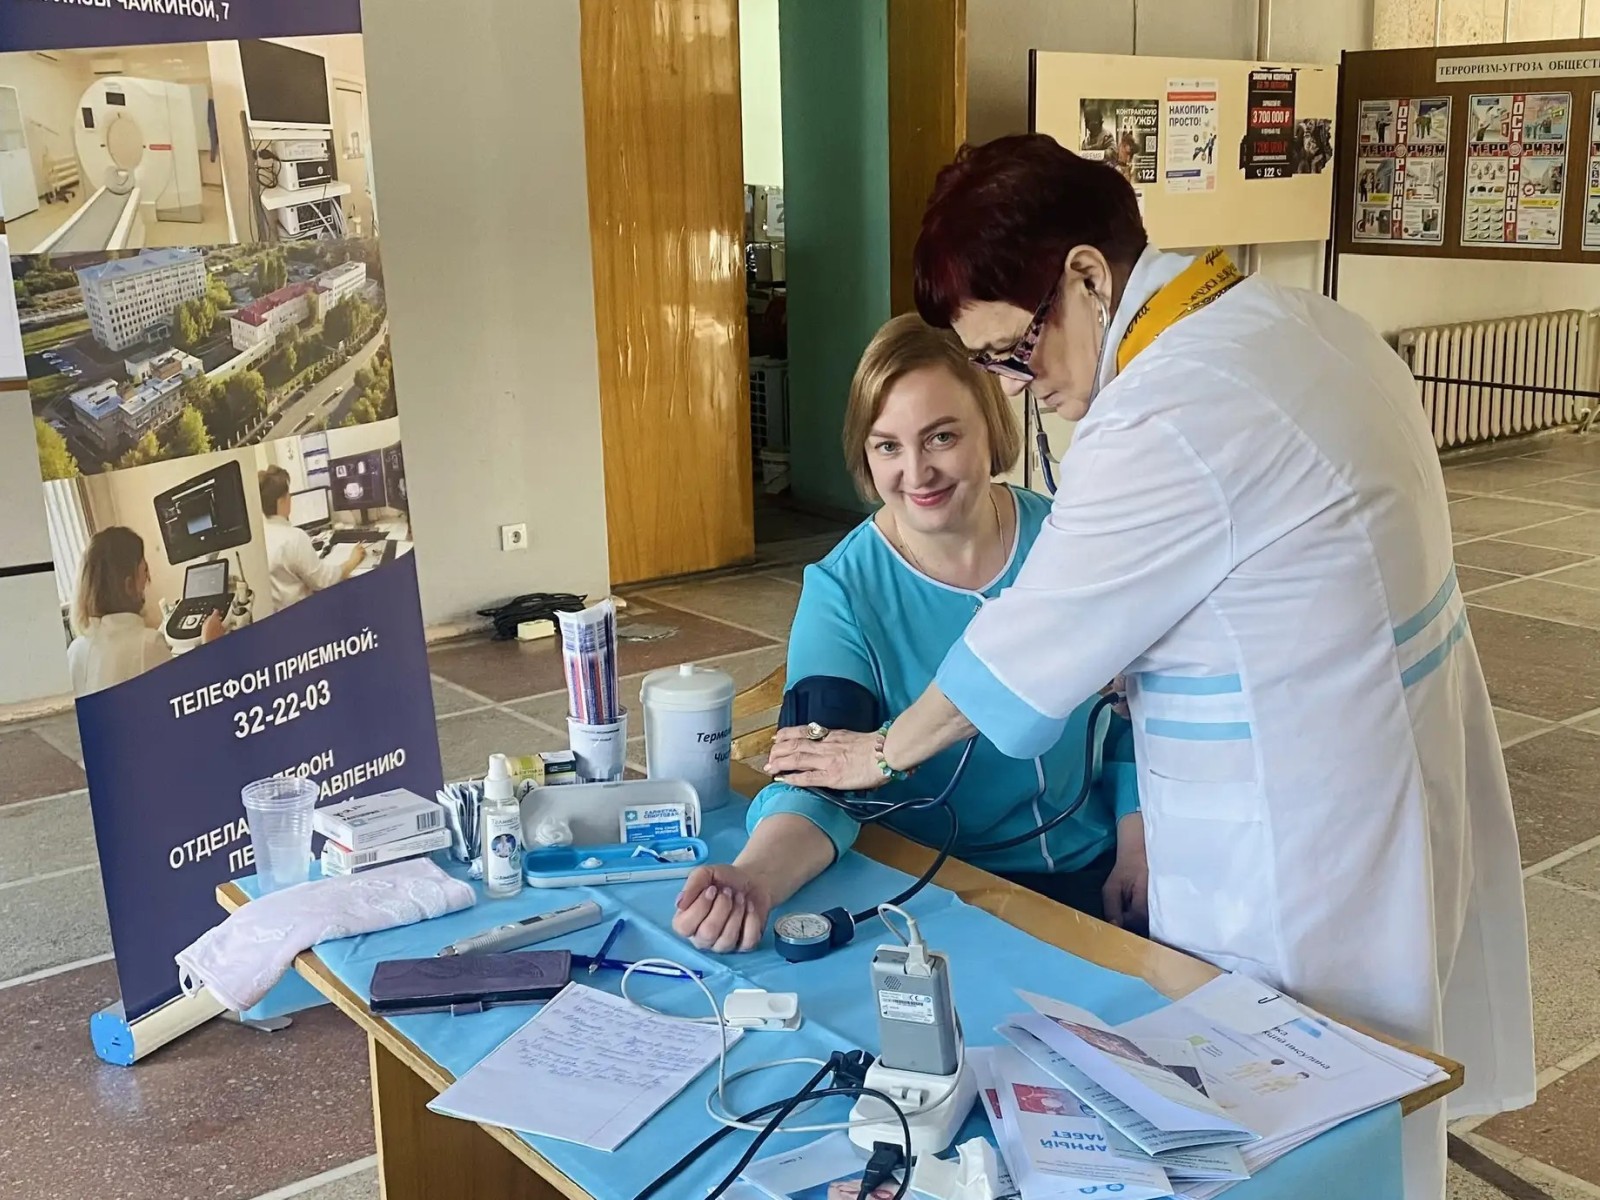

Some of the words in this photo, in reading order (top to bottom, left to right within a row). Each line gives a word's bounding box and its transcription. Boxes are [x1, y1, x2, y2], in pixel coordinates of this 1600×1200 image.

[221, 3, 230, 20] 7
[1439, 61, 1543, 76] ТЕРРОРИЗМ-УГРОЗА
[1549, 57, 1600, 71] ОБЩЕСТ
[1169, 105, 1209, 115] НАКОПИТЬ
[1122, 116, 1157, 126] СЛУЖБУ
[1169, 117, 1201, 127] ПРОСТО!
[1142, 169, 1155, 180] 122
[1263, 167, 1275, 178] 122
[169, 667, 271, 719] ТЕЛЕФОН
[274, 627, 379, 683] ПРИЕМНОЙ:
[233, 680, 331, 739] 32-22-03
[319, 748, 406, 801] АВЛЕНИЮ
[169, 817, 251, 870] ОТДЕЛА
[229, 844, 256, 873] ПЕ
